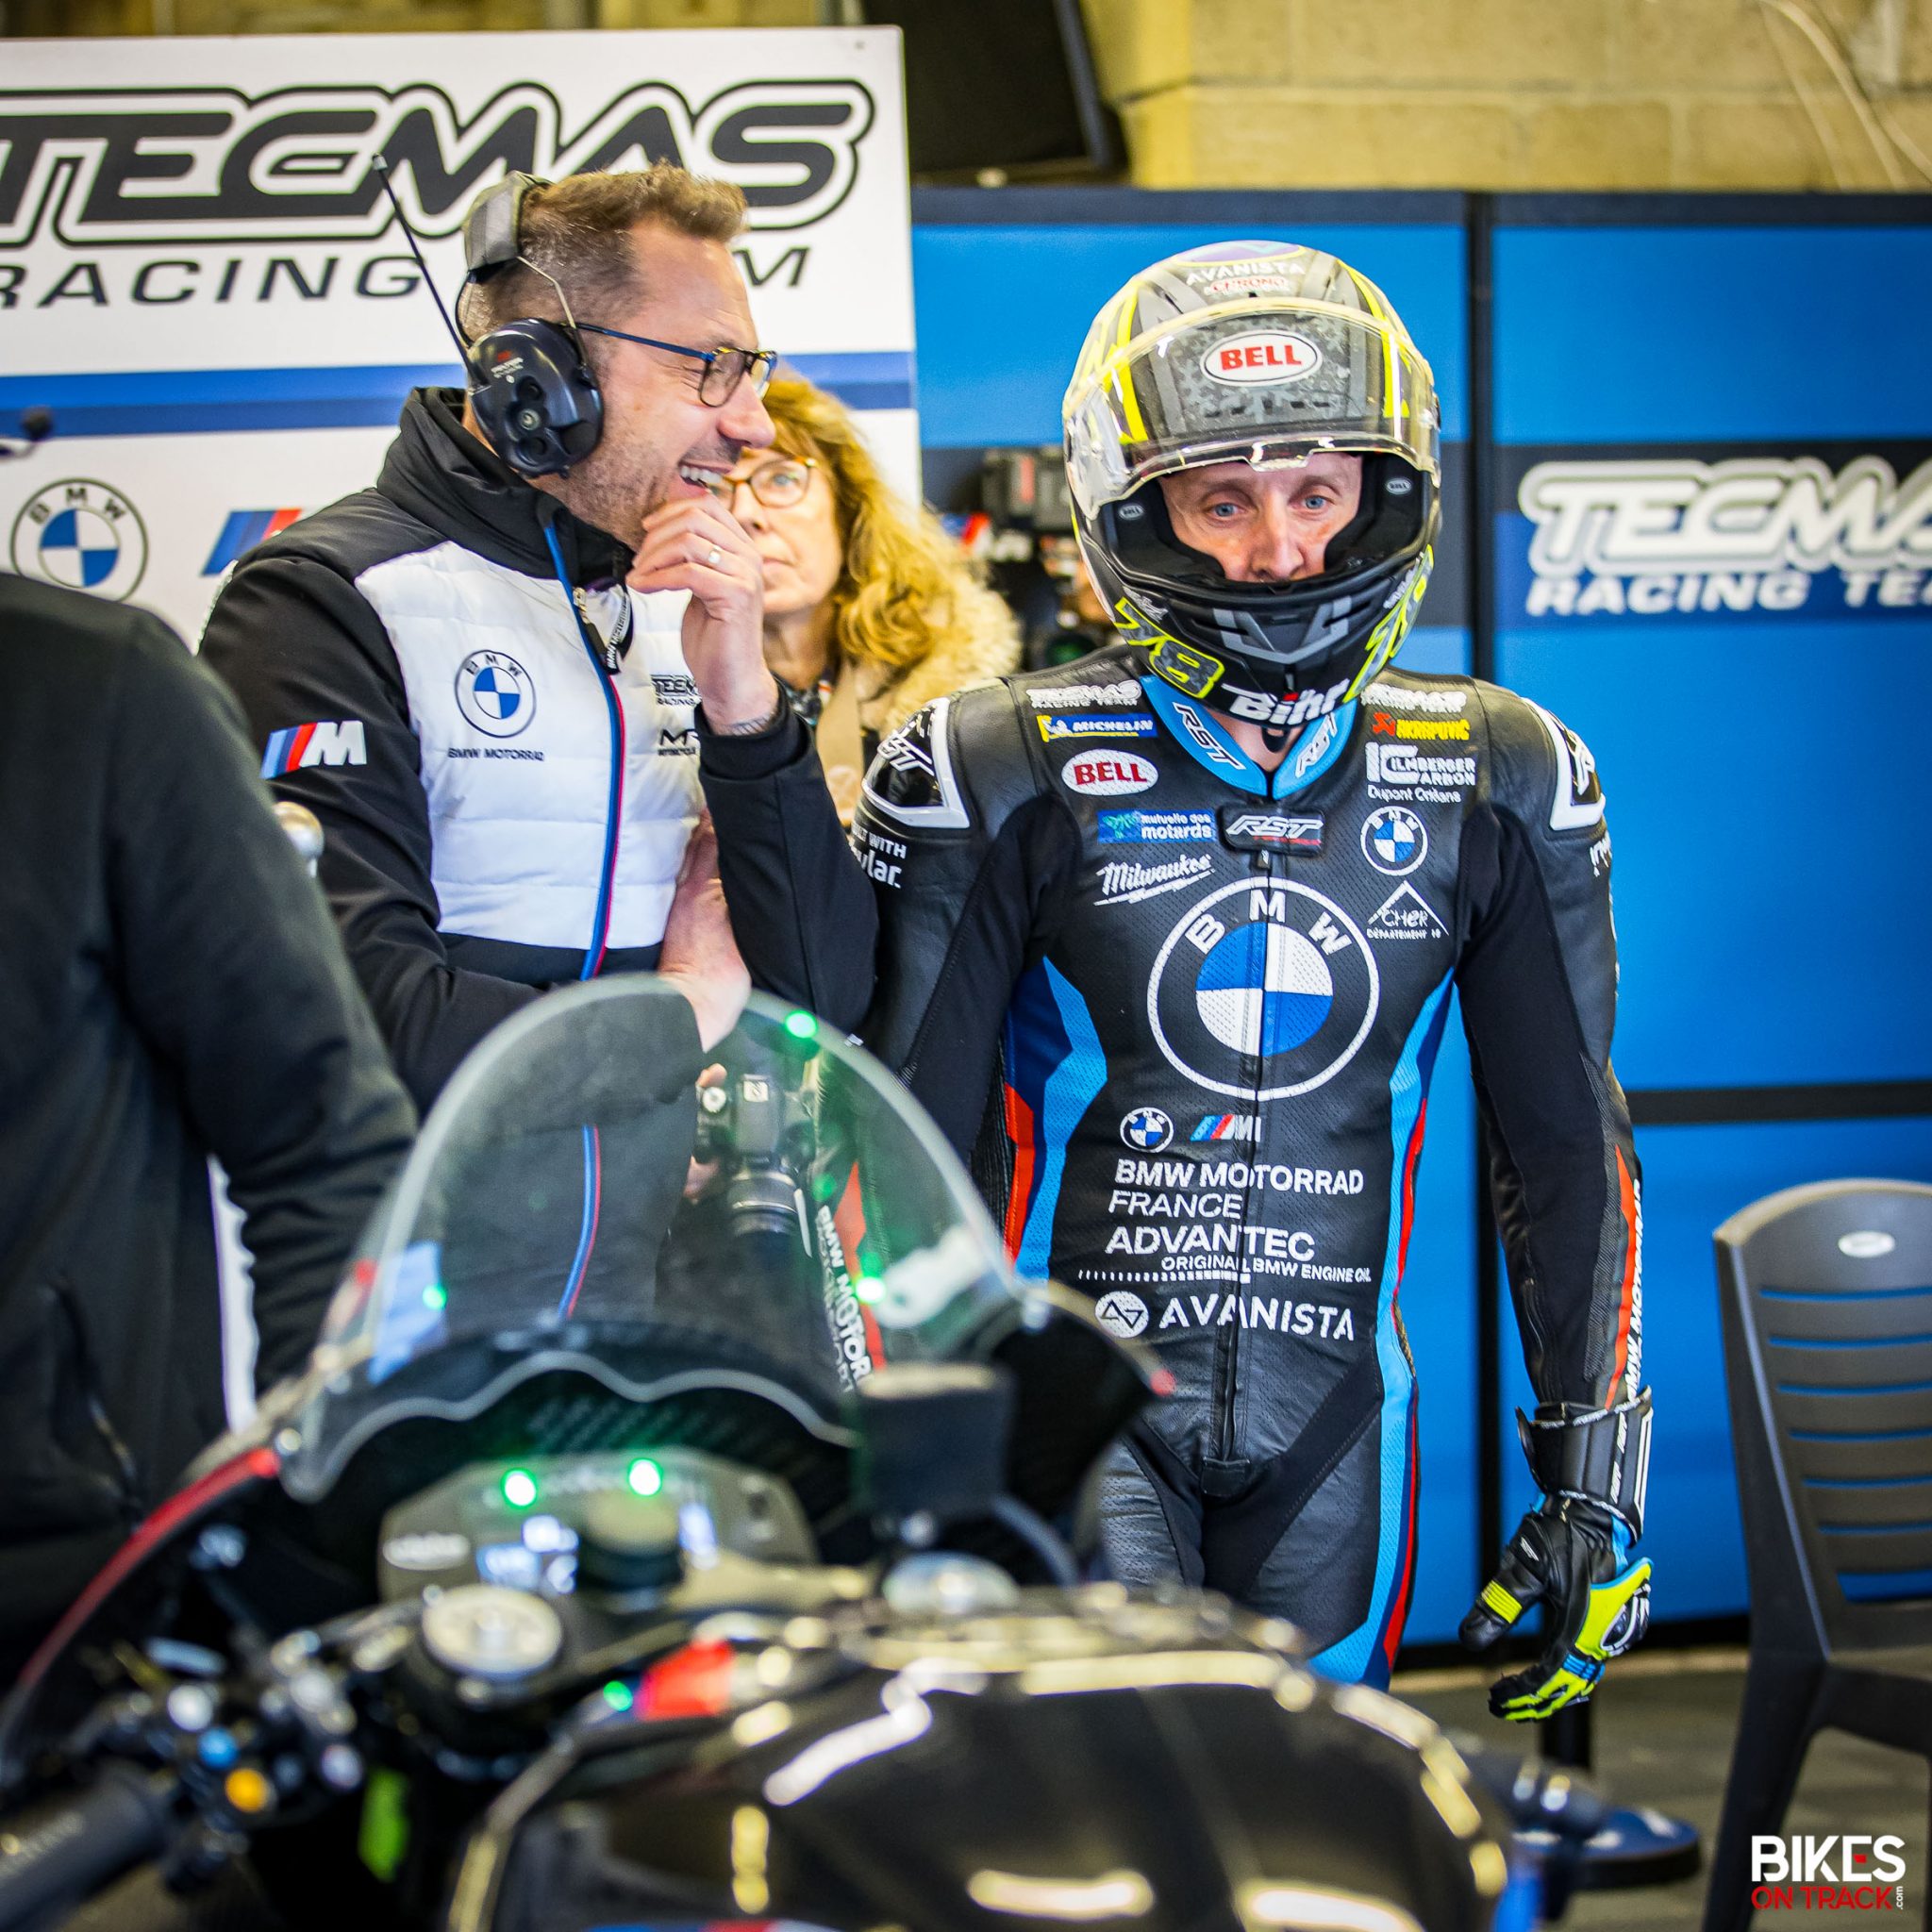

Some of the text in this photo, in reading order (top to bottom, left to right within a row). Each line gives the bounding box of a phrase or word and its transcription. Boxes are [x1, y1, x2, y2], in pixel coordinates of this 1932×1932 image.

[1186, 261, 1307, 286] AVANISTA
[1220, 344, 1302, 370] BELL
[1525, 571, 1811, 616] RACING
[1072, 720, 1153, 732] MICHELIN
[1173, 702, 1247, 771] RST
[1073, 760, 1148, 786] BELL
[1225, 814, 1324, 839] RST
[869, 832, 907, 858] WITH
[1095, 854, 1212, 896] Milwaukee
[1184, 889, 1354, 956] BMW
[1114, 1158, 1364, 1195] BMW MOTORRAD
[1108, 1189, 1243, 1219] FRANCE
[1105, 1223, 1316, 1261] ADVANTEC
[1161, 1255, 1251, 1274] ORIGINAL
[1253, 1257, 1298, 1277] BMW
[1301, 1265, 1354, 1282] ENGINE
[1158, 1292, 1355, 1341] AVANISTA
